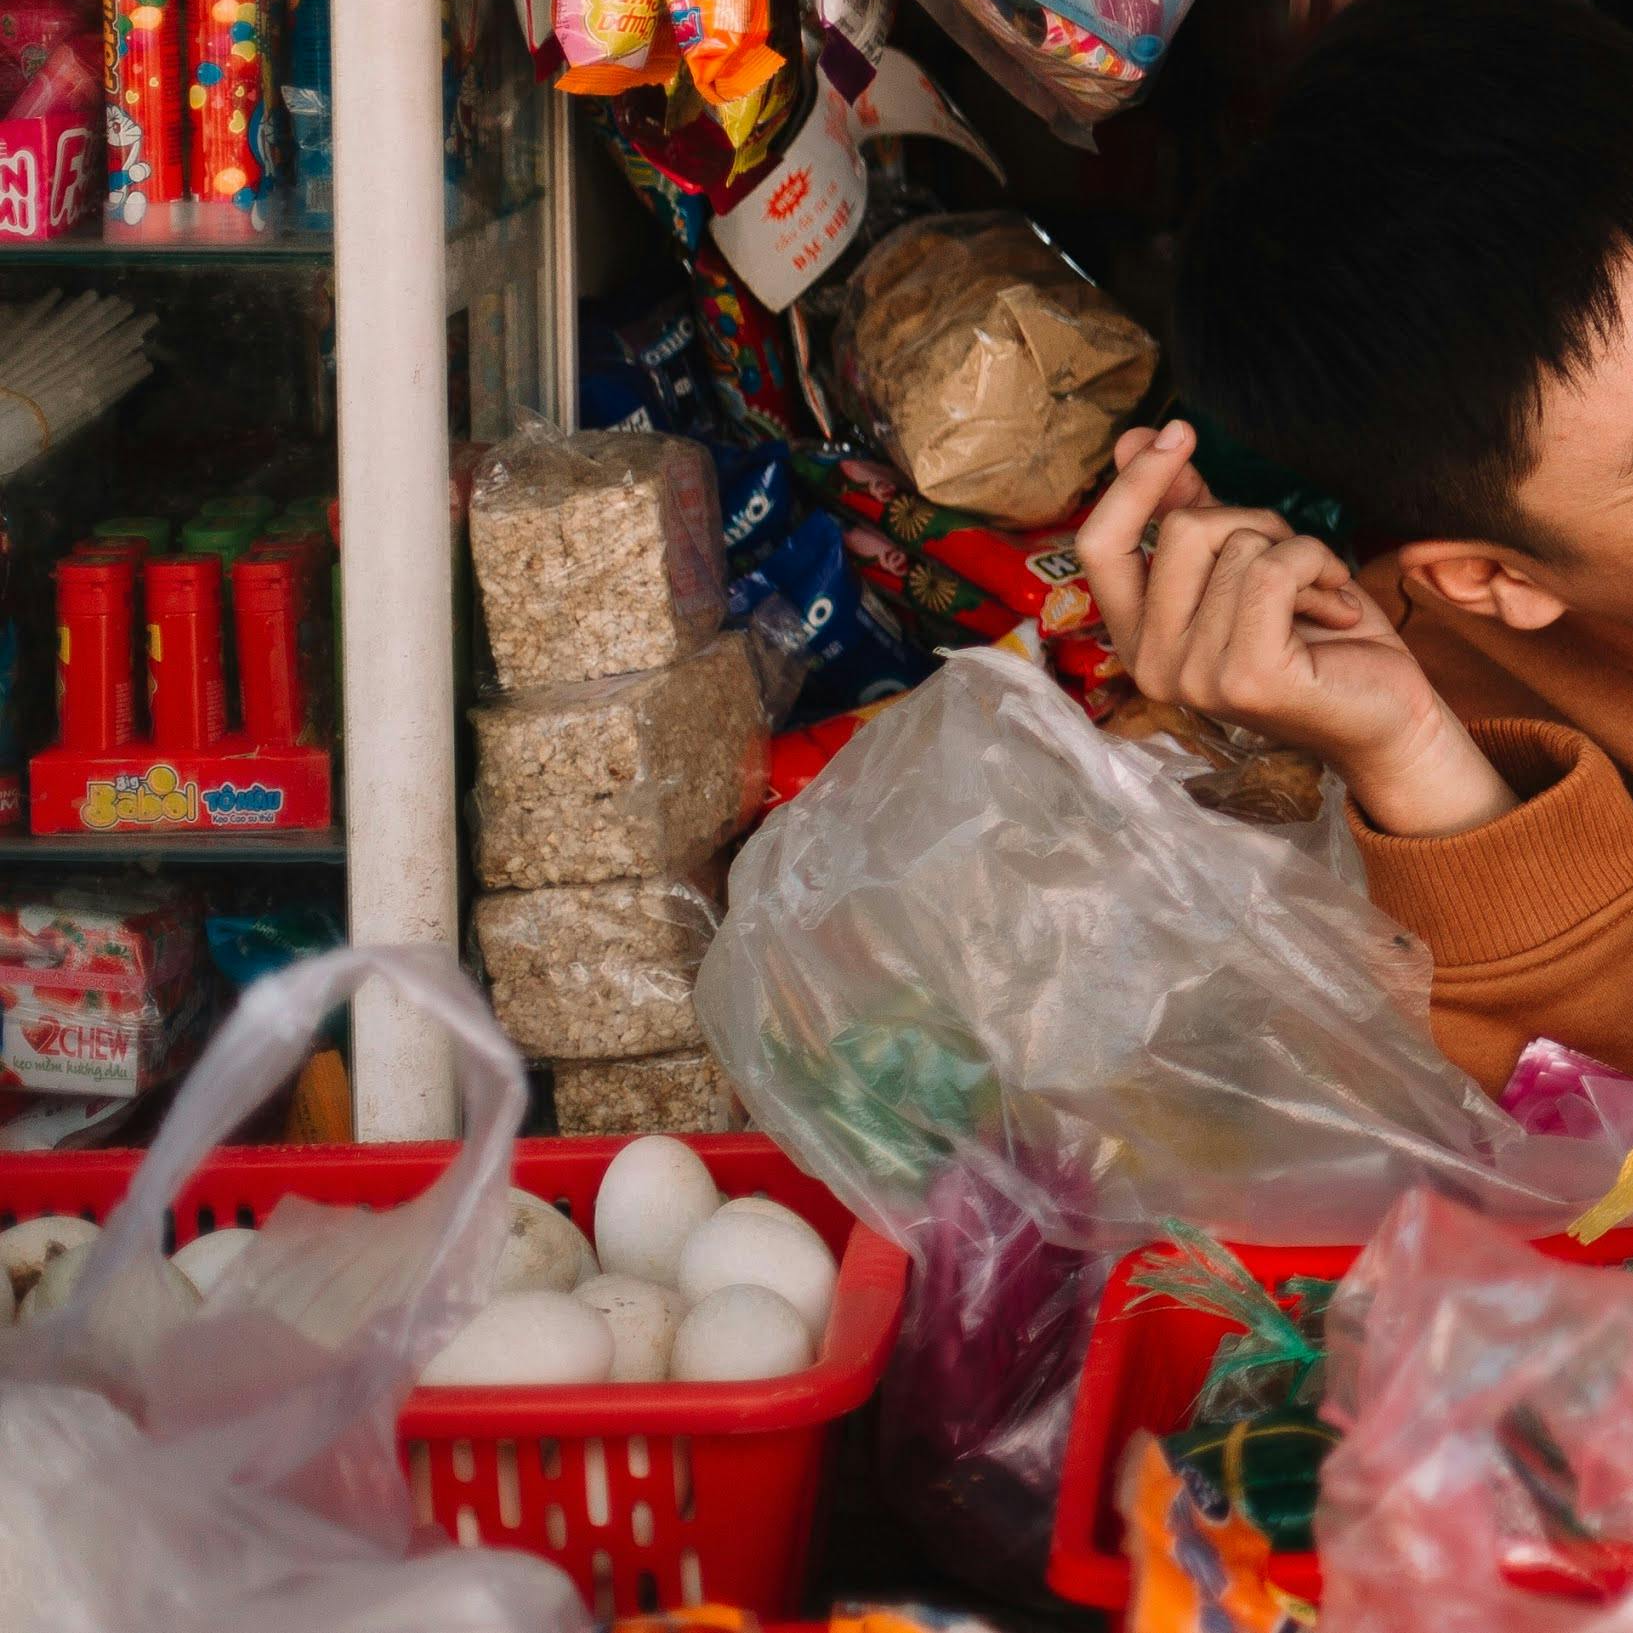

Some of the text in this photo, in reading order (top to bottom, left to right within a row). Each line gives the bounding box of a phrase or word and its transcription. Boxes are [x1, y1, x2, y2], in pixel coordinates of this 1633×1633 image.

[80, 764, 198, 829] Babol
[116, 776, 139, 790] Big
[37, 1016, 128, 1062] 2CHEW
